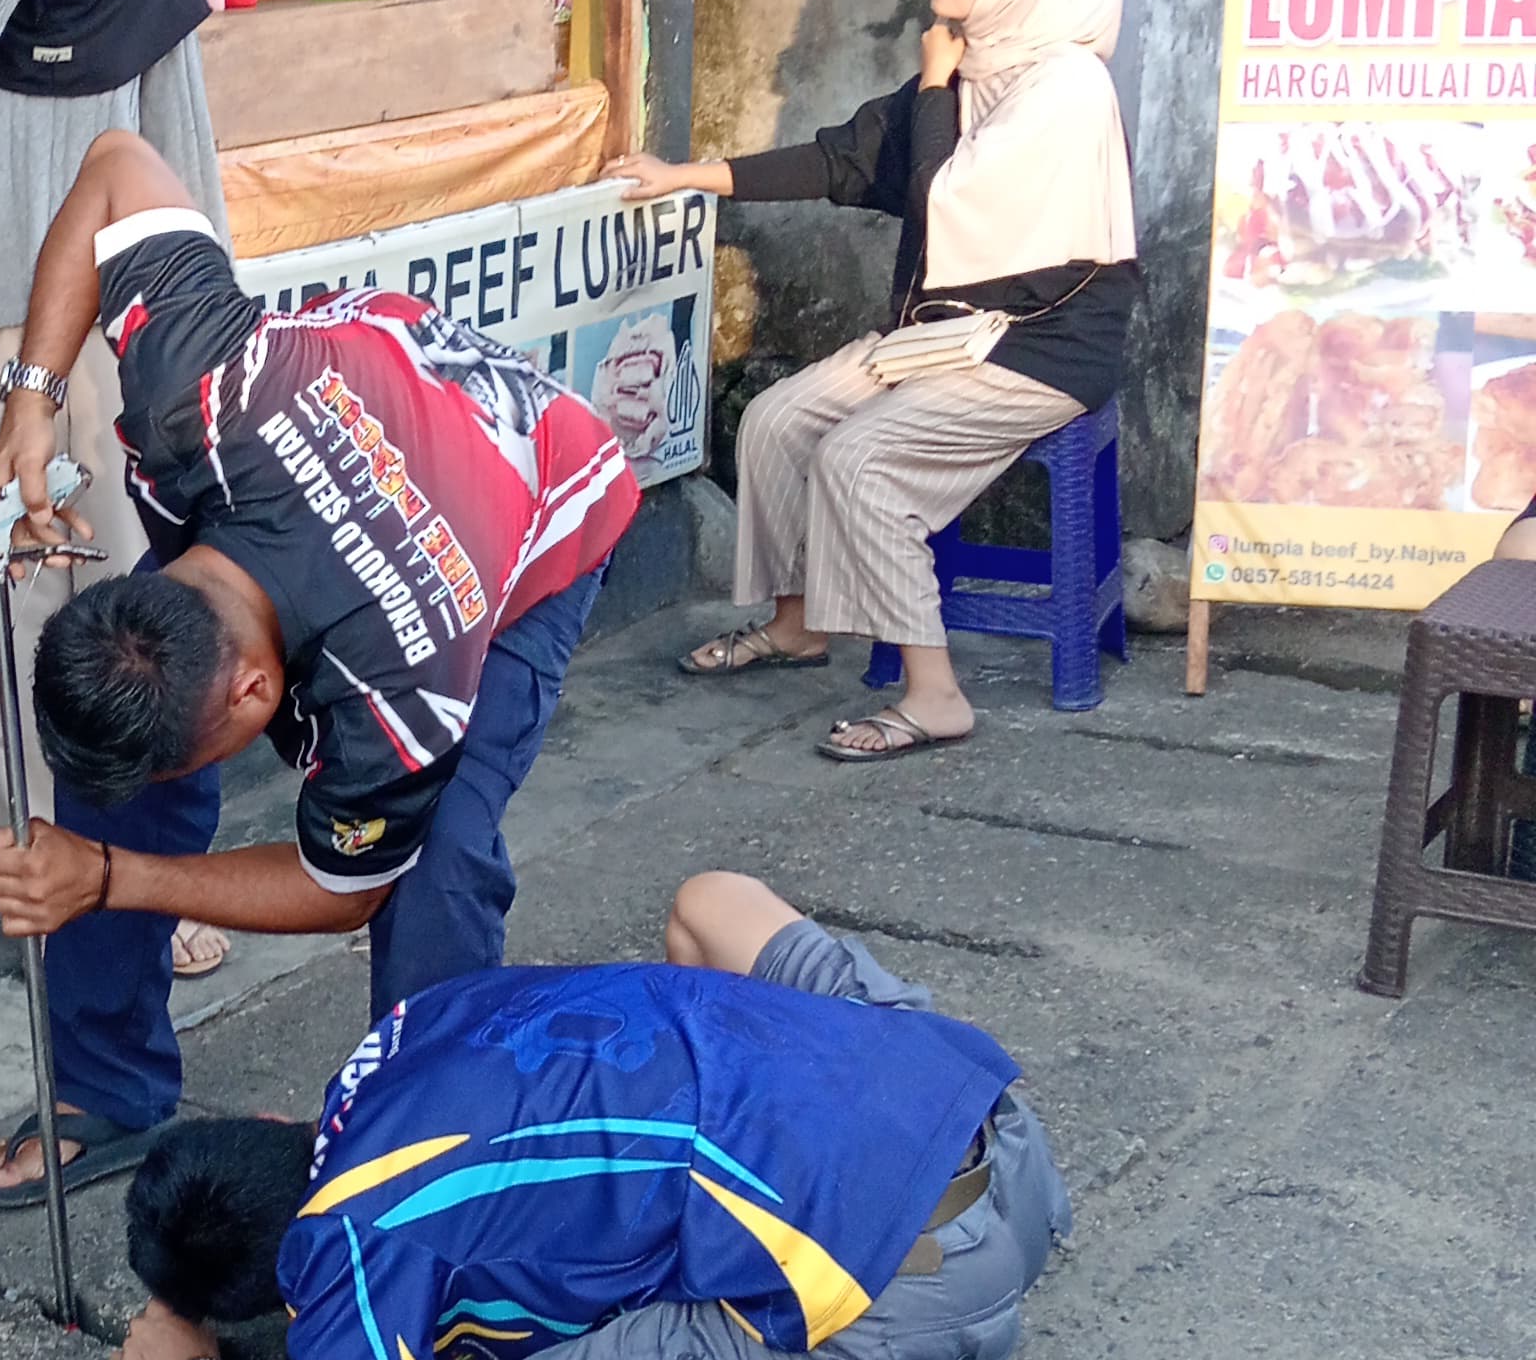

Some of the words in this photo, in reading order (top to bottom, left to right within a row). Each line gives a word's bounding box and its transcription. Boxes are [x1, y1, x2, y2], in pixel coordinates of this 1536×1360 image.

[1241, 63, 1351, 99] HARGA
[1367, 62, 1471, 99] MULAI
[1486, 62, 1536, 99] DA
[554, 193, 704, 309] LUMER
[256, 410, 351, 525] SELATAN
[663, 437, 698, 460] HALAL
[330, 520, 438, 667] BENGKULU
[394, 528, 450, 607] REAL
[414, 514, 488, 633] FIRE
[1232, 536, 1304, 557] lumpia
